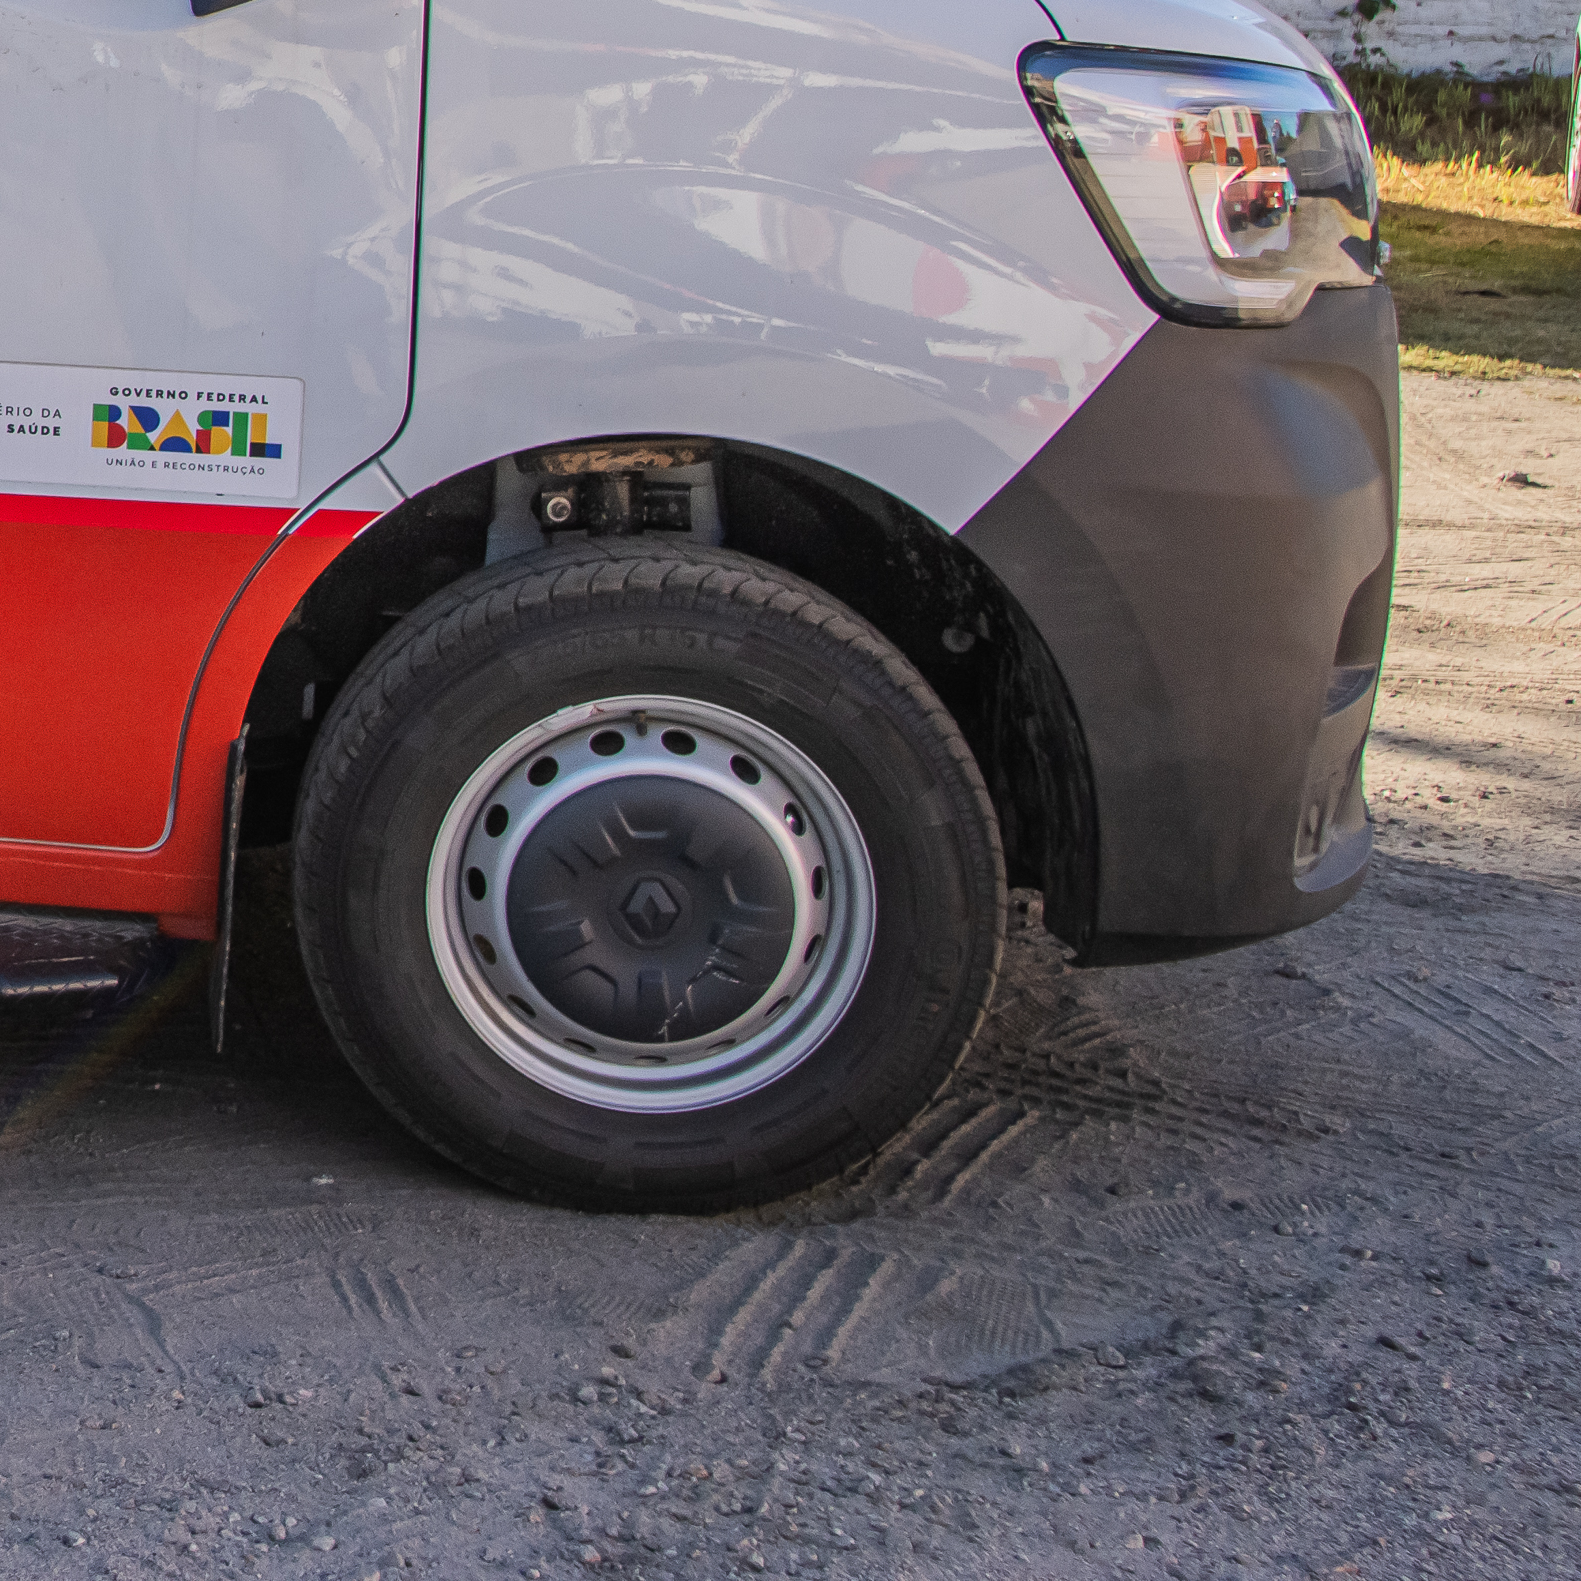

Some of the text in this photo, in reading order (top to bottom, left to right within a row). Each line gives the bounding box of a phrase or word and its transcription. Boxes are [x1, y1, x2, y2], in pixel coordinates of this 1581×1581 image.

[109, 386, 269, 405] GOVERNO FEDERAL
[41, 408, 62, 419] DA
[6, 422, 61, 437] SAÚDE
[91, 403, 283, 459] BRASIL
[106, 457, 265, 476] UNIÃO E RECONSTRUÇÃO
